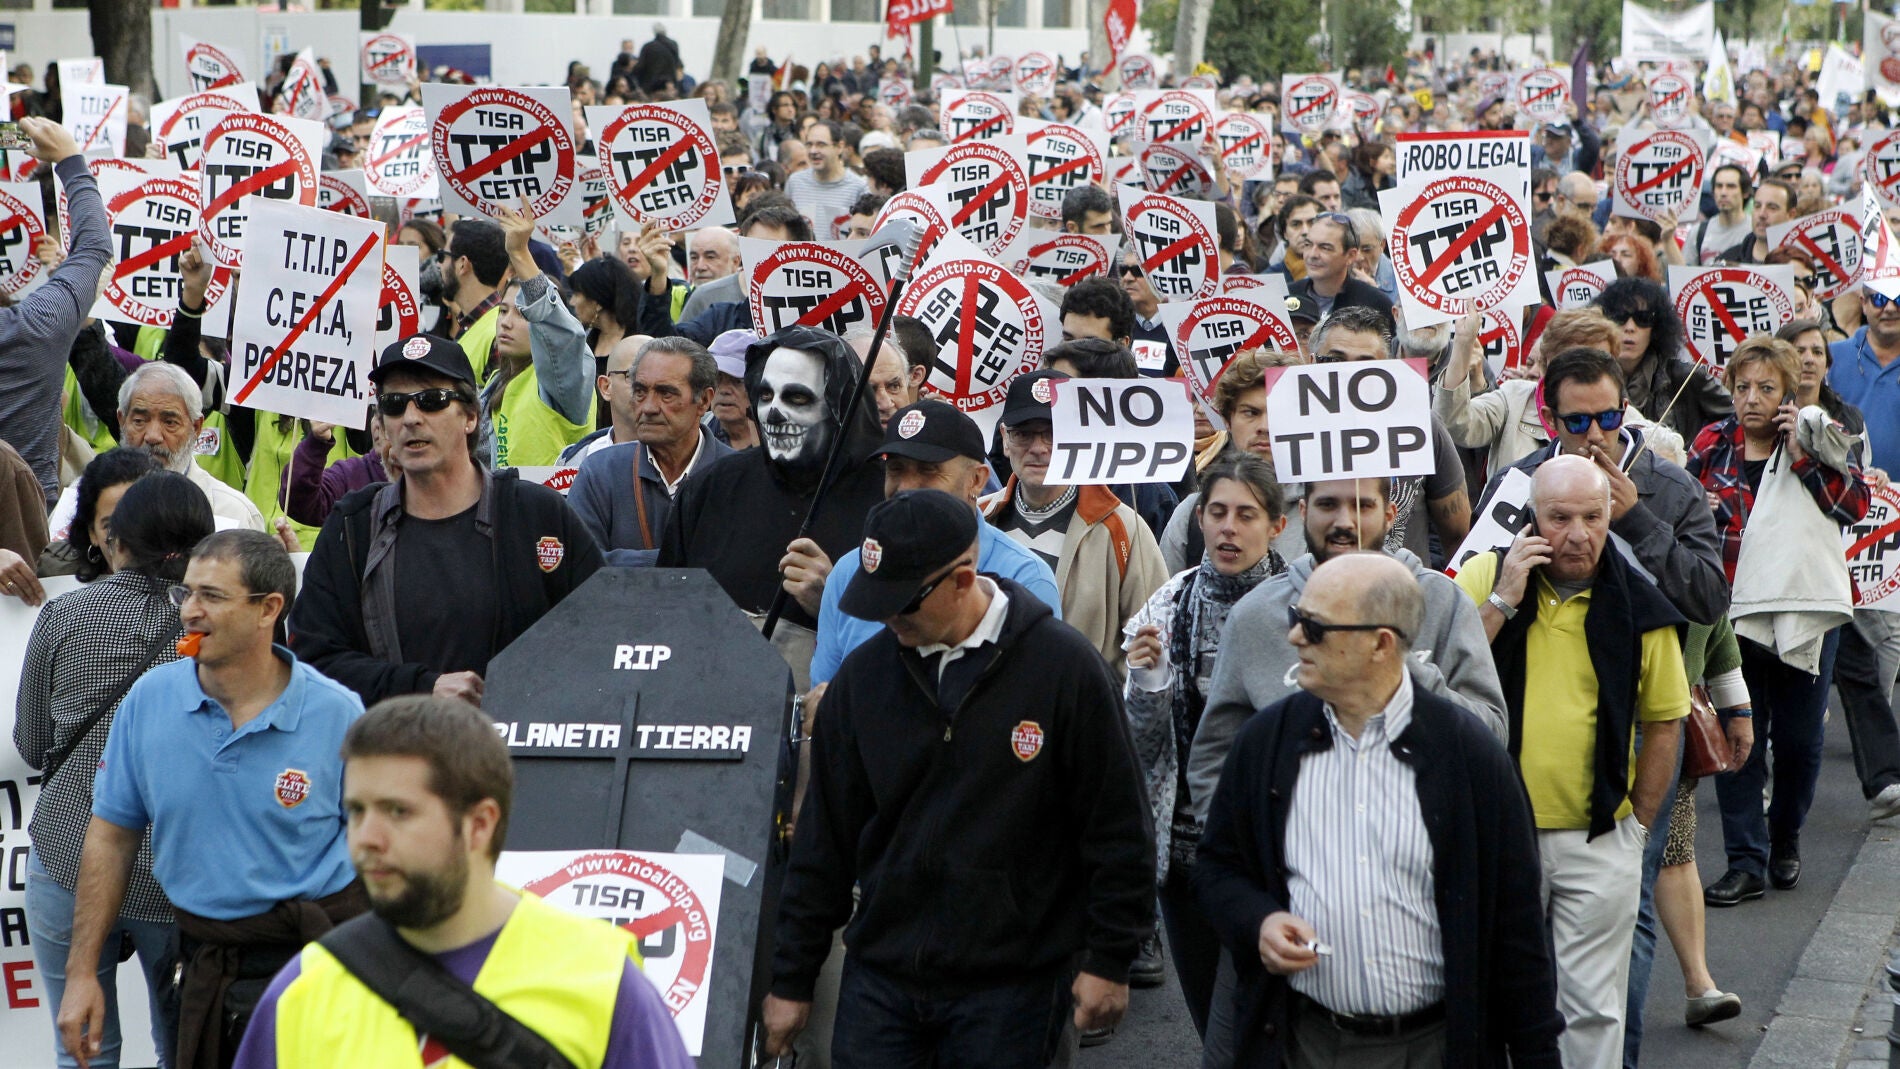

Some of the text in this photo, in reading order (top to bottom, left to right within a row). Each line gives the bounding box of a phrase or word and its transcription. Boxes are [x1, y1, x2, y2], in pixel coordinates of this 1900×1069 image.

[1293, 96, 1332, 112] TTIP
[1525, 86, 1561, 102] TTIP
[468, 91, 571, 151] www.noalttip.org
[475, 110, 524, 130] TISA
[967, 104, 992, 116] TISA
[1165, 104, 1190, 115] TISA
[621, 108, 714, 156] www.noalttip.org
[629, 127, 670, 142] TISA
[952, 117, 1003, 141] TTIP
[1148, 118, 1203, 142] TTIP
[1230, 123, 1250, 133] TISA
[221, 117, 315, 189] www.noalttip.org
[225, 137, 273, 161] TISA
[450, 134, 551, 175] TTIP
[1046, 138, 1077, 156] TISA
[1219, 135, 1260, 155] TTIP
[1402, 141, 1528, 178] ¡ROBO LEGAL
[1653, 146, 1682, 158] TISA
[384, 161, 419, 177] CETA
[434, 118, 453, 178] Tratados
[451, 178, 474, 202] que
[613, 146, 698, 188] TTIP
[945, 145, 1026, 192] www.noalttip.org
[951, 164, 990, 183] TISA
[1028, 154, 1089, 187] TTIP
[1154, 155, 1176, 167] TISA
[1228, 157, 1254, 168] CETA
[479, 176, 542, 199] CETA
[600, 140, 619, 196] Tratados
[618, 195, 638, 217] que
[1148, 168, 1195, 191] TTIP
[1632, 162, 1693, 189] TTIP
[640, 184, 695, 212] CETA
[948, 182, 1010, 226] TIP
[1423, 180, 1523, 227] www.noalttip.org
[1431, 199, 1478, 219] TISA
[1645, 190, 1683, 205] CETA
[146, 200, 192, 226] TISA
[217, 216, 248, 238] CE
[1142, 199, 1215, 256] www.noalttip.org
[1147, 212, 1180, 234] TISA
[960, 222, 999, 244] ETA
[1410, 217, 1507, 271] TTIP
[114, 224, 190, 273] TTI
[1056, 250, 1088, 265] TISA
[1134, 231, 1200, 274] TTIP
[1845, 234, 1856, 267] TISA
[775, 248, 884, 307] www.noalttip.org
[782, 268, 833, 289] TISA
[1394, 225, 1416, 287] Tratados
[1414, 285, 1438, 305] que
[1442, 260, 1500, 294] CETA
[1567, 287, 1592, 300] TISA
[1746, 271, 1793, 324] OBRECEN
[750, 279, 765, 339] Tratado
[763, 293, 865, 336] TTIP
[1193, 301, 1293, 346] www.noalttip.org
[1693, 304, 1706, 341] TISA
[1749, 296, 1771, 335] ETA
[1201, 320, 1245, 338] TISA
[1711, 287, 1749, 365] TTIP
[974, 322, 1024, 386] CETA
[244, 343, 364, 400] POBREZA.
[957, 395, 986, 412] que
[1077, 385, 1164, 427] NO
[1297, 367, 1397, 416] NO
[1057, 442, 1187, 479] TIPP
[1274, 425, 1426, 476] TIPP
[1847, 525, 1900, 561] TIP
[1850, 564, 1883, 582] ETA
[613, 645, 671, 670] RIP
[493, 722, 752, 752] PLANETA TIERRA
[275, 773, 311, 794] ELITE
[567, 858, 707, 941] www.noalttip.org
[573, 884, 645, 911] TISA
